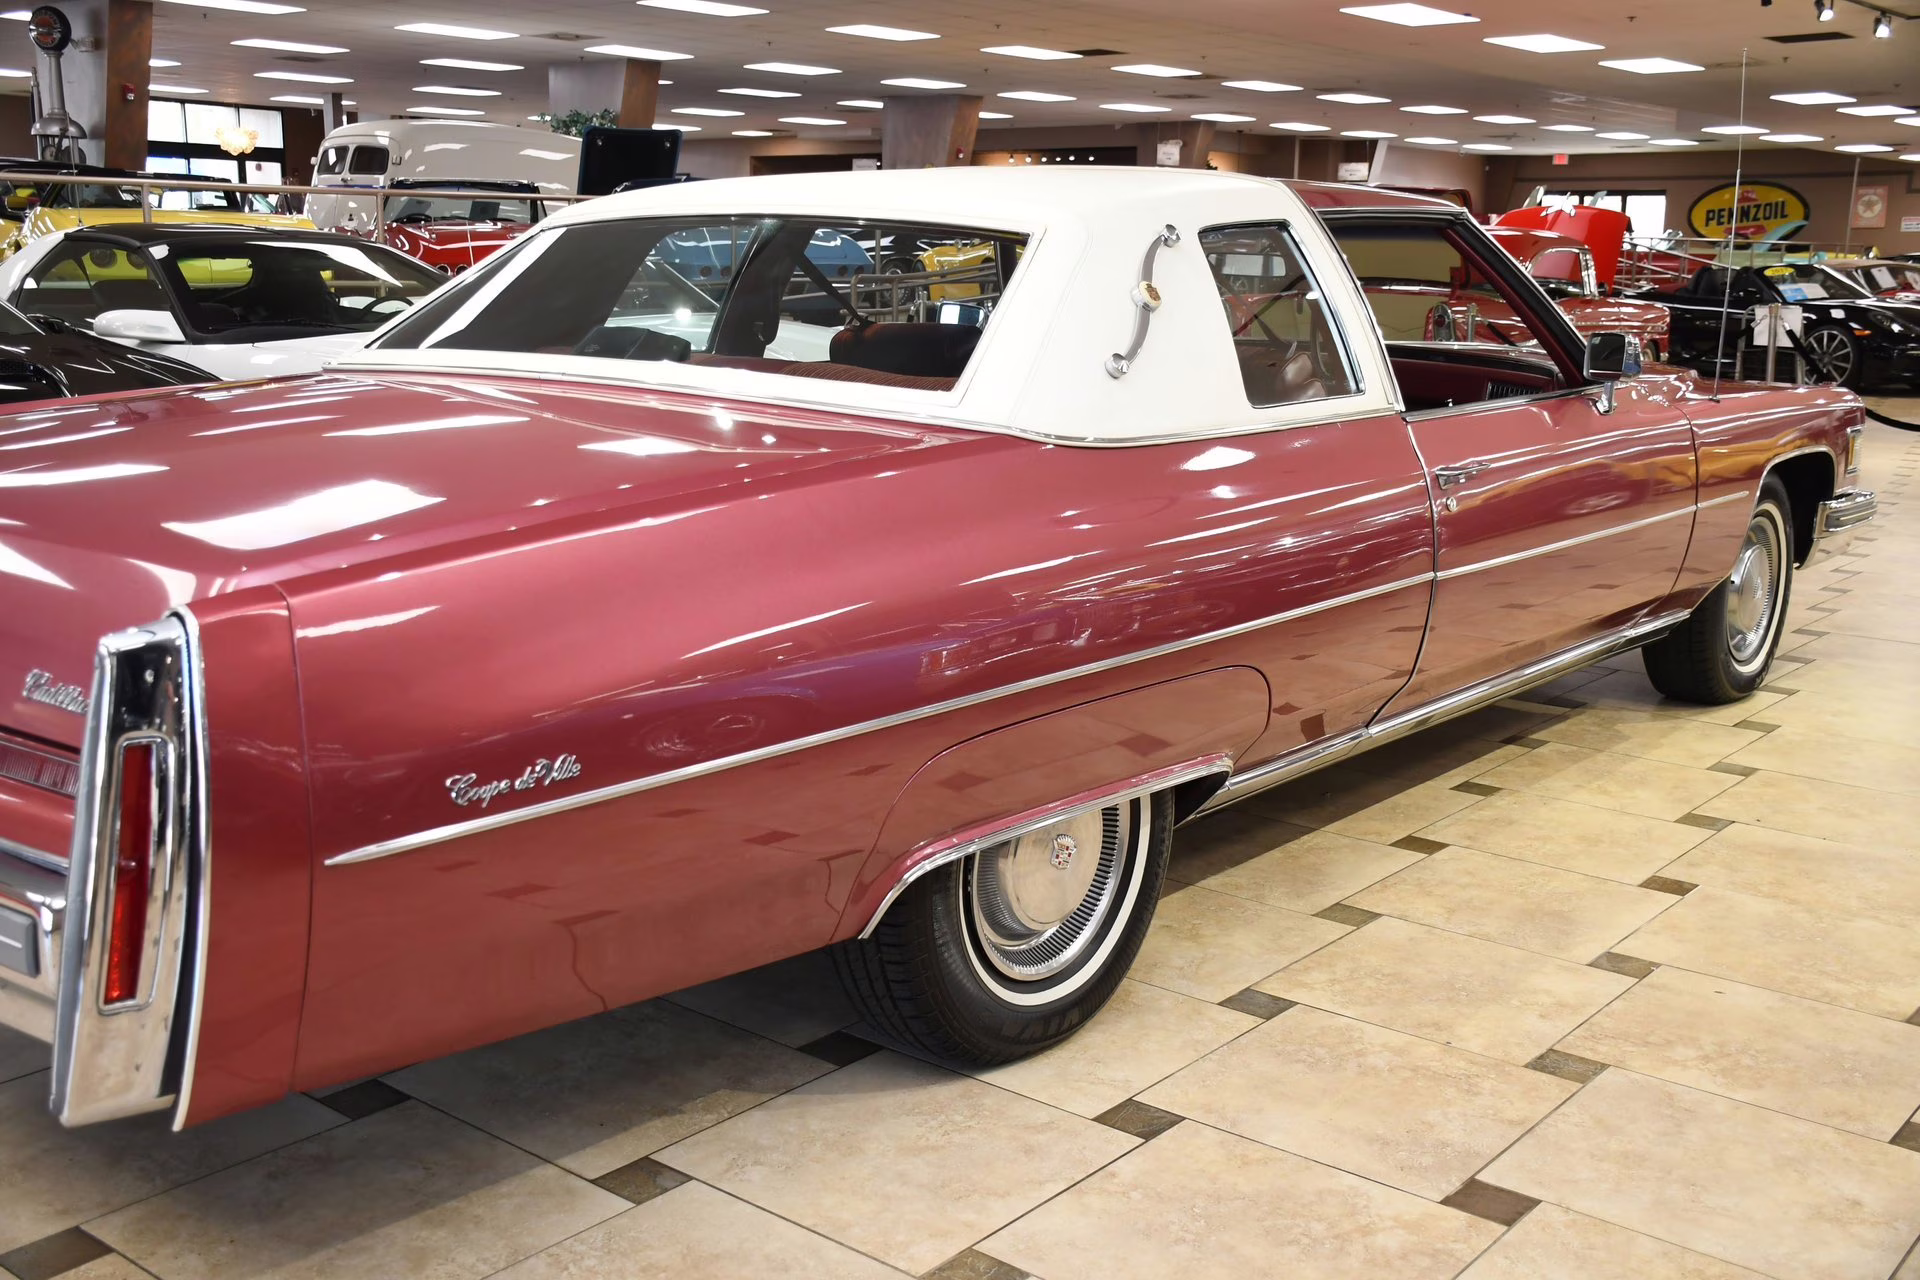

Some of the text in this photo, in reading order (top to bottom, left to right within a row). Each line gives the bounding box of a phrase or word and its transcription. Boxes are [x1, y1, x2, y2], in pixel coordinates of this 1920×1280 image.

[1704, 200, 1789, 228] PENNZOIL
[445, 772, 511, 808] Coupe
[514, 765, 538, 790] de
